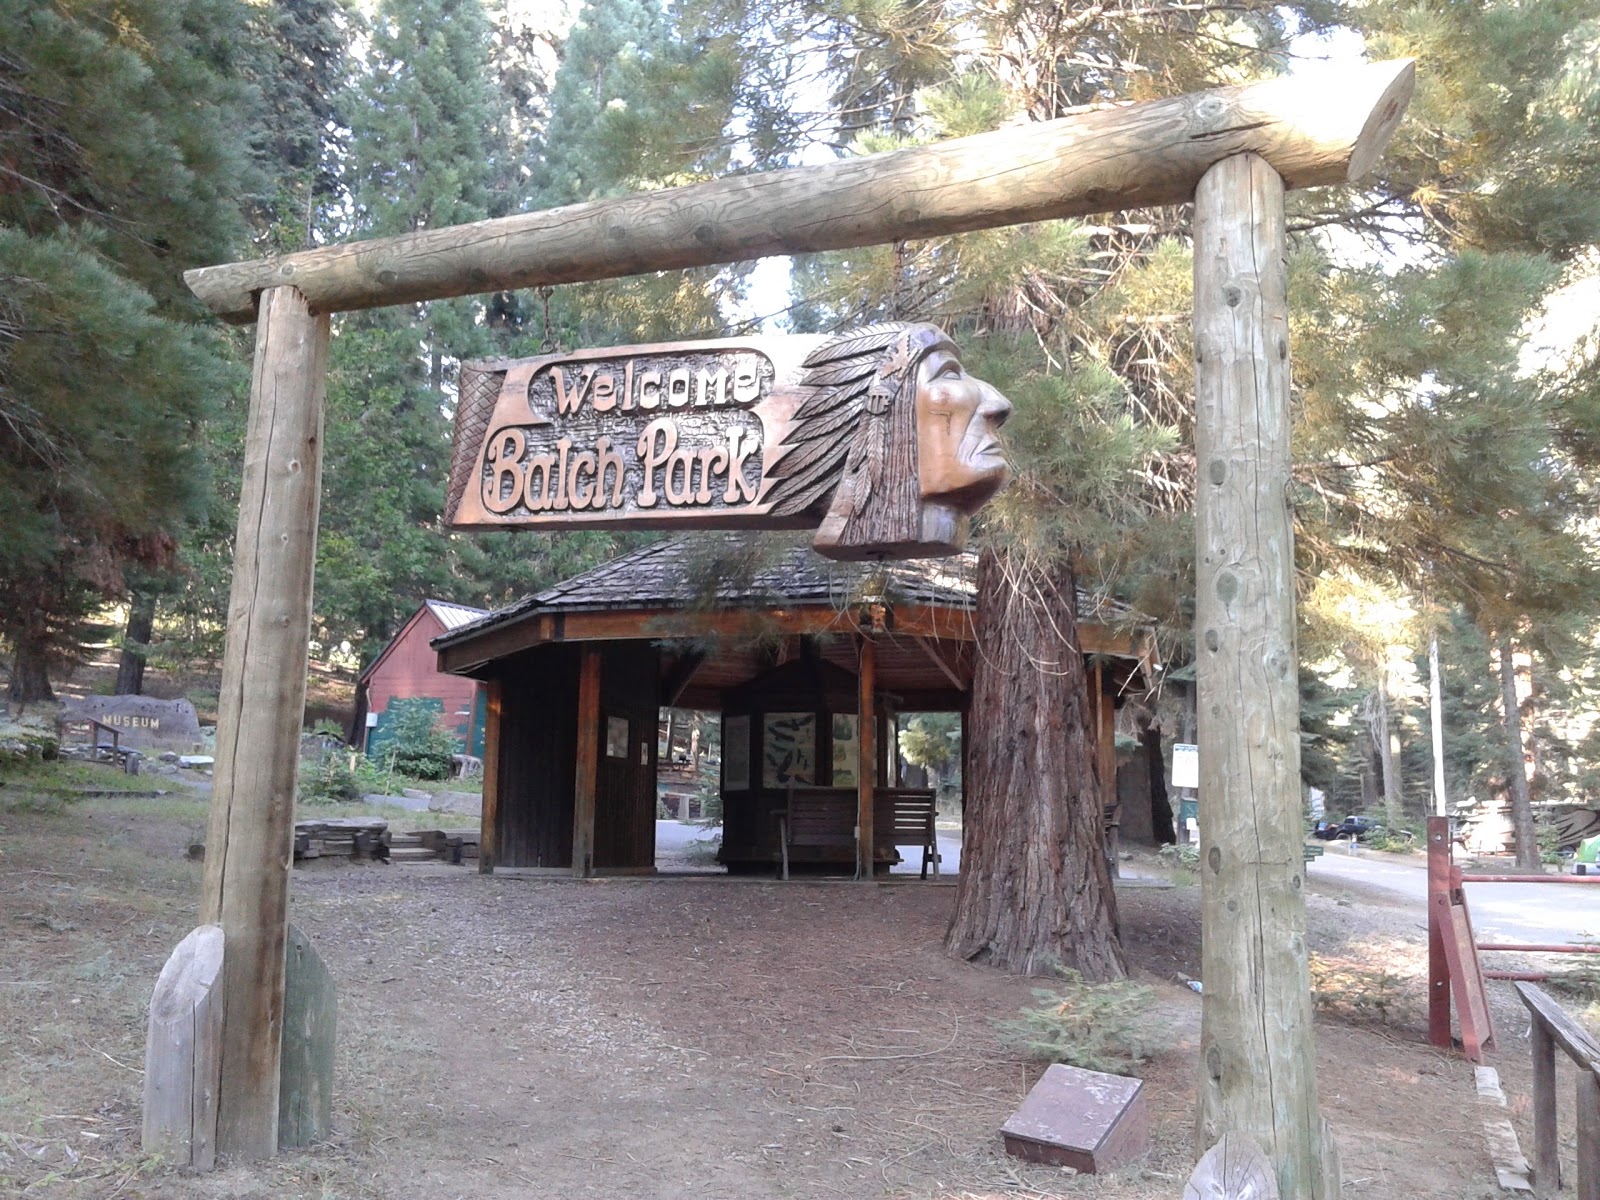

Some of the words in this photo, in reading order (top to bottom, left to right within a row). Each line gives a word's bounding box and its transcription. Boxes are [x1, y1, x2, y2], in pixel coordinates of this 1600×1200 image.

[550, 358, 761, 415] Welcome
[484, 428, 623, 513] Balch
[638, 418, 758, 507] Park
[102, 715, 160, 729] MUSEUM
